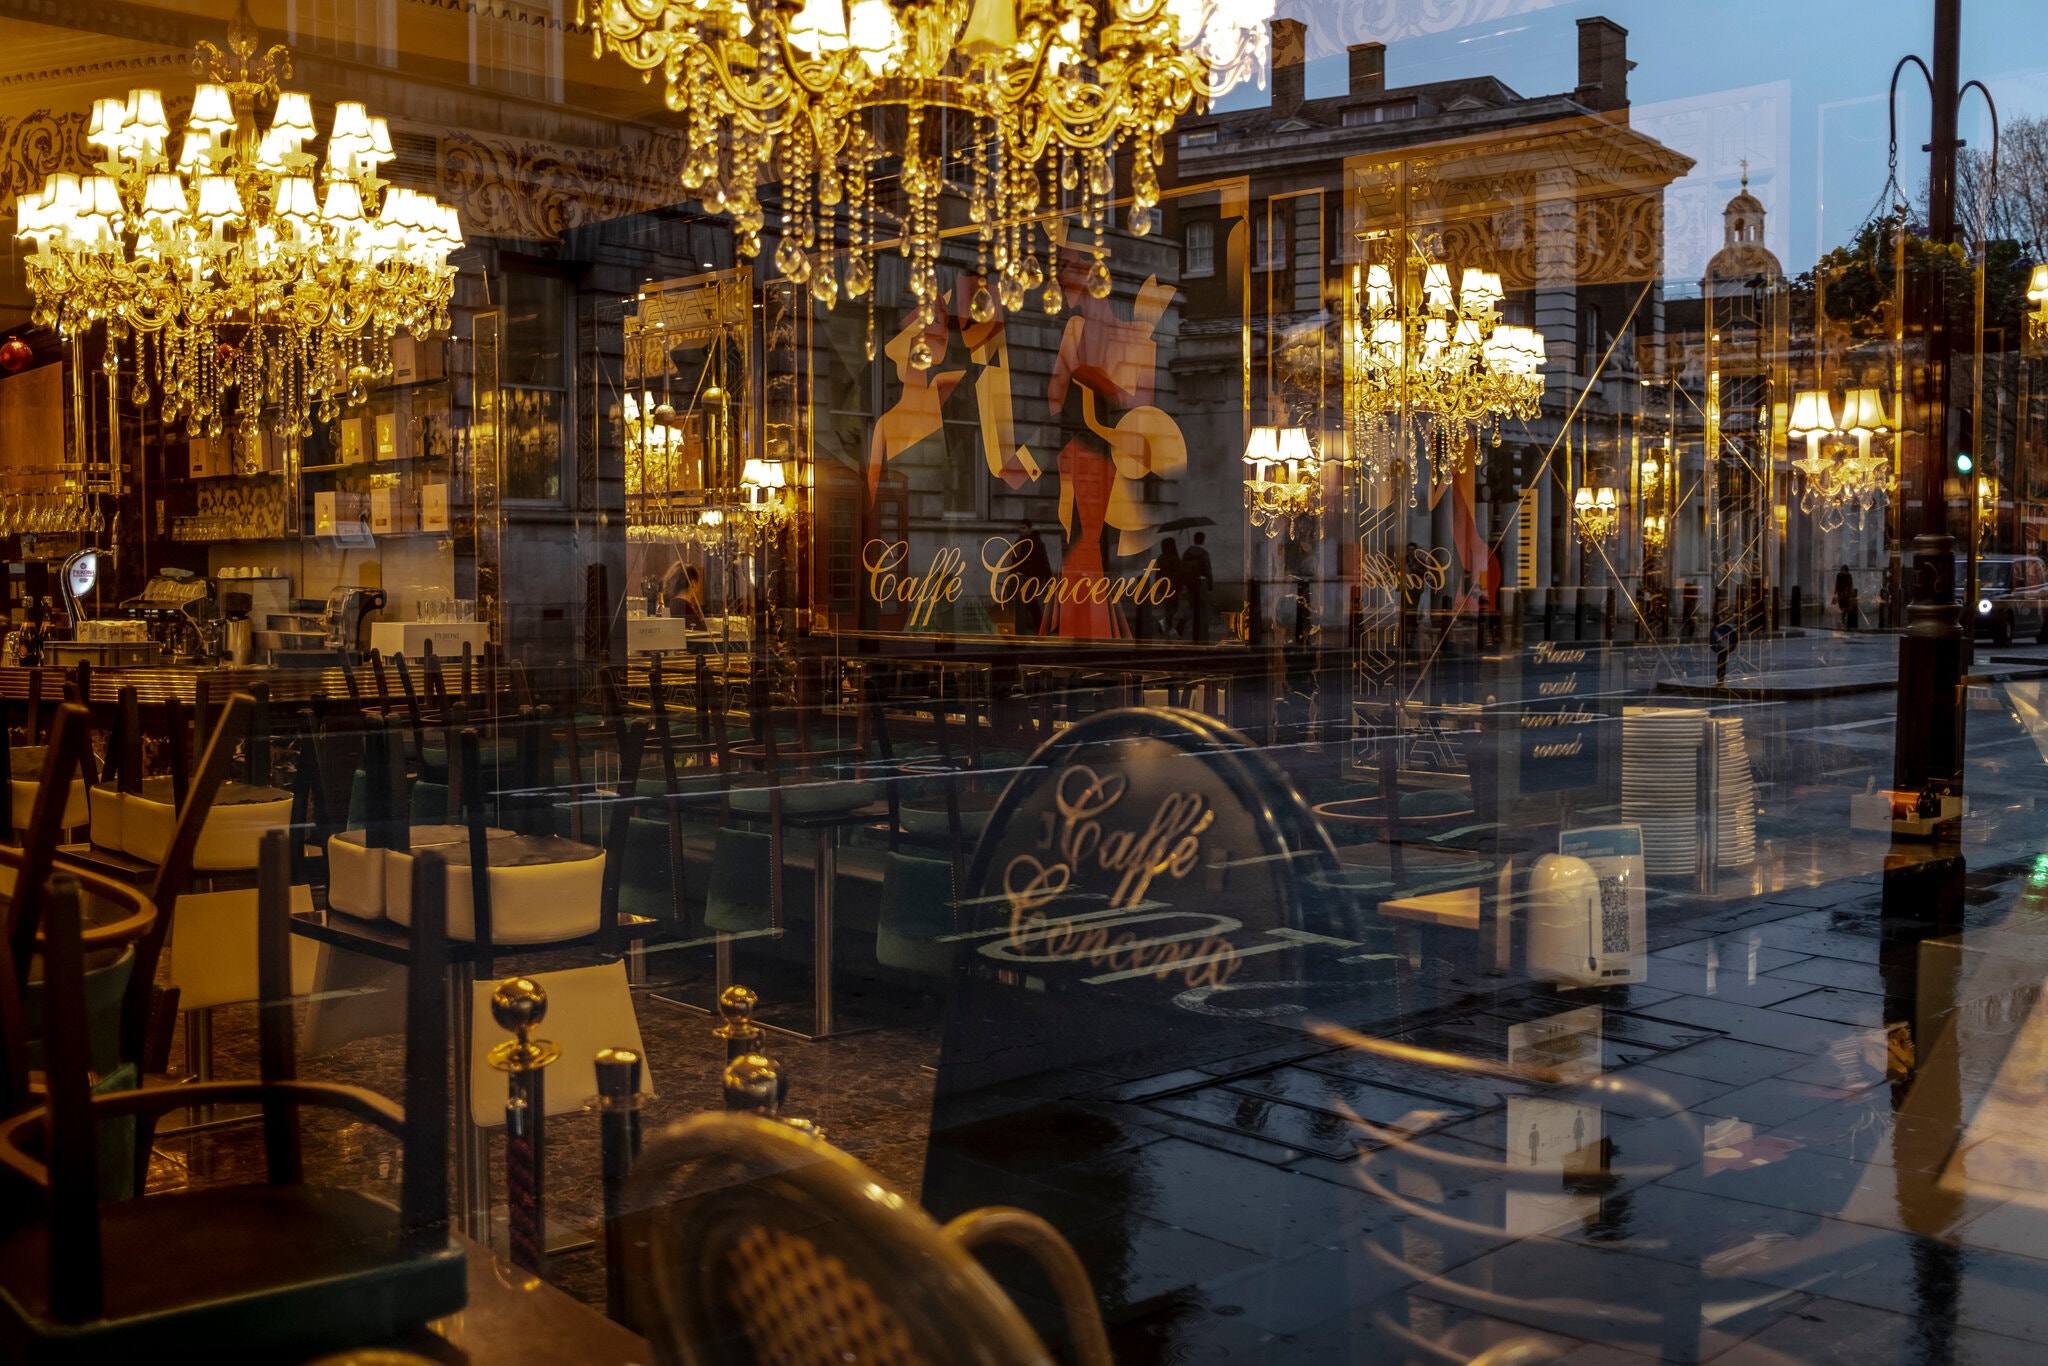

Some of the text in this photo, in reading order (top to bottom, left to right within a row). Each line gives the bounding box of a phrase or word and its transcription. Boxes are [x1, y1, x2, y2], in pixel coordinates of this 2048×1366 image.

[862, 536, 1176, 626] Caffé Concerto
[1533, 641, 1586, 664] Please
[1539, 672, 1577, 695] wait
[1056, 765, 1216, 908] Caffé
